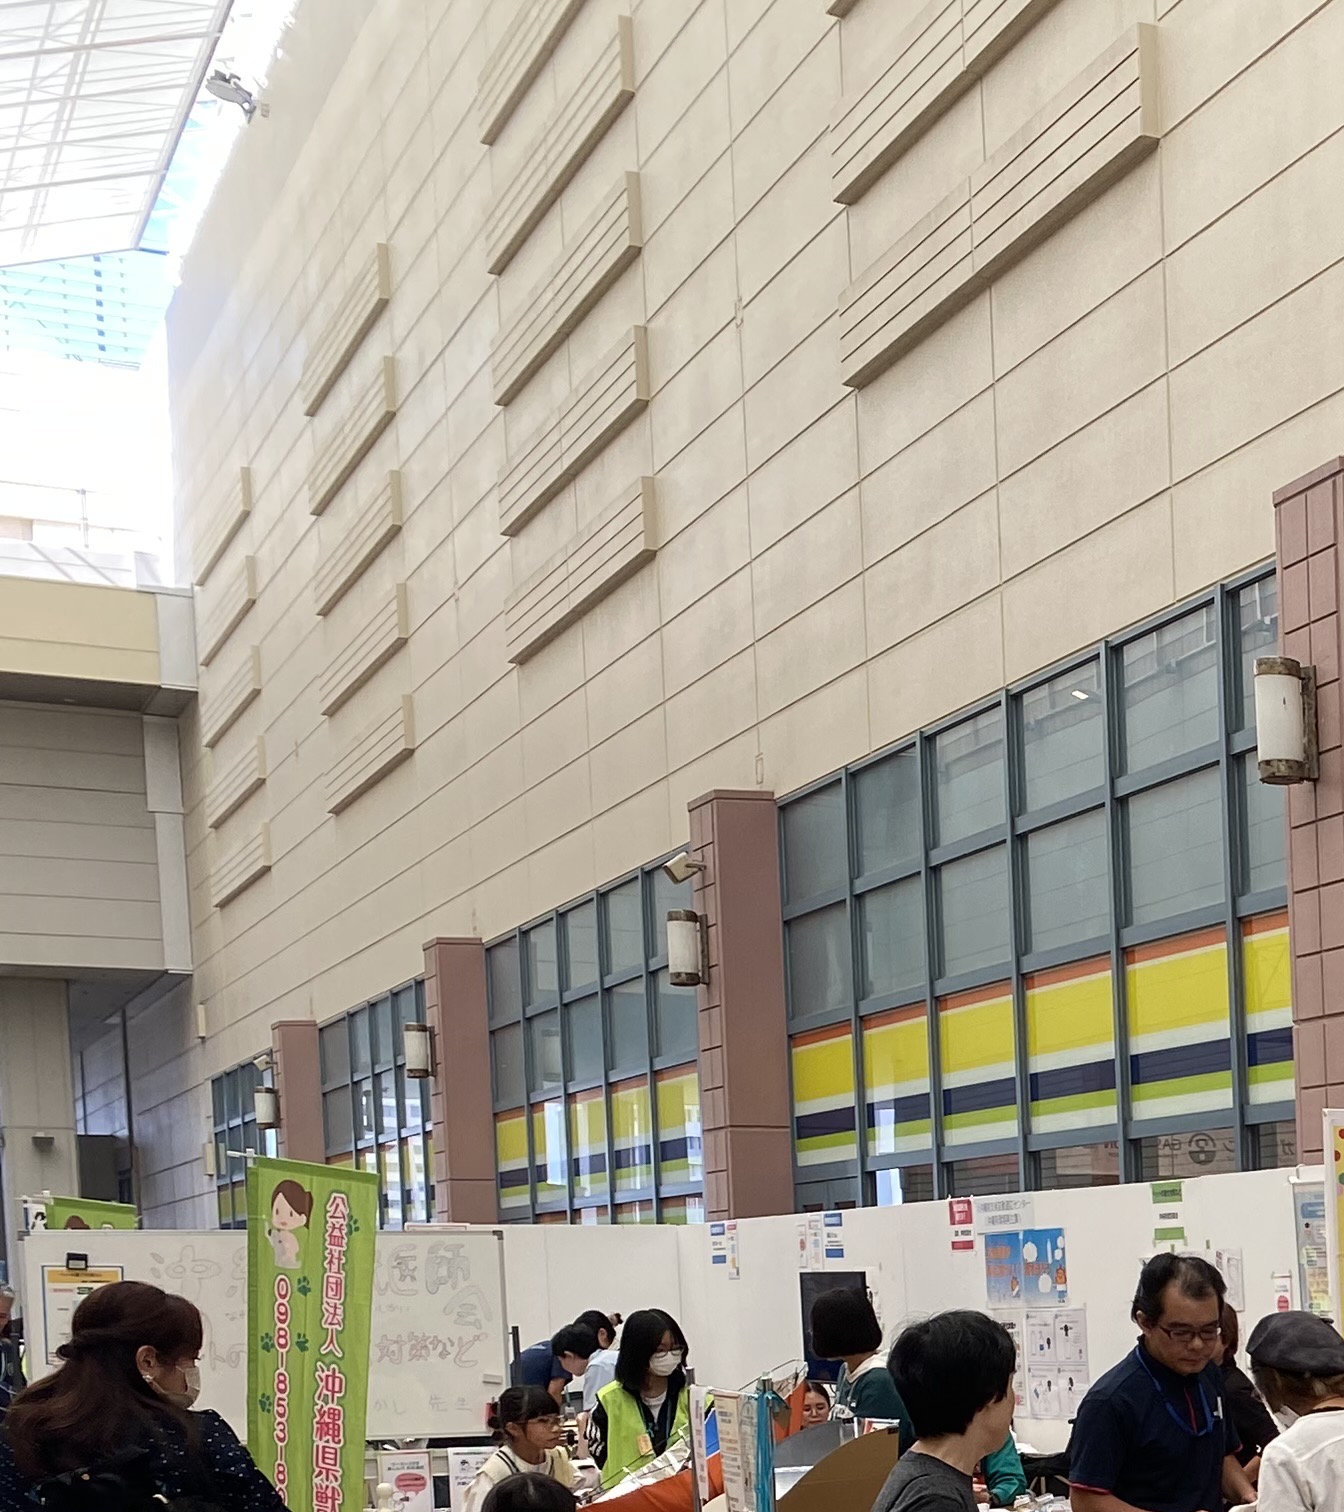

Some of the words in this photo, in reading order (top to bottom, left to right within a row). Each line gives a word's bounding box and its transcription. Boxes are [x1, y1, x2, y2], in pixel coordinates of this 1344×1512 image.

[321, 1193, 349, 1359] 公益社団法人
